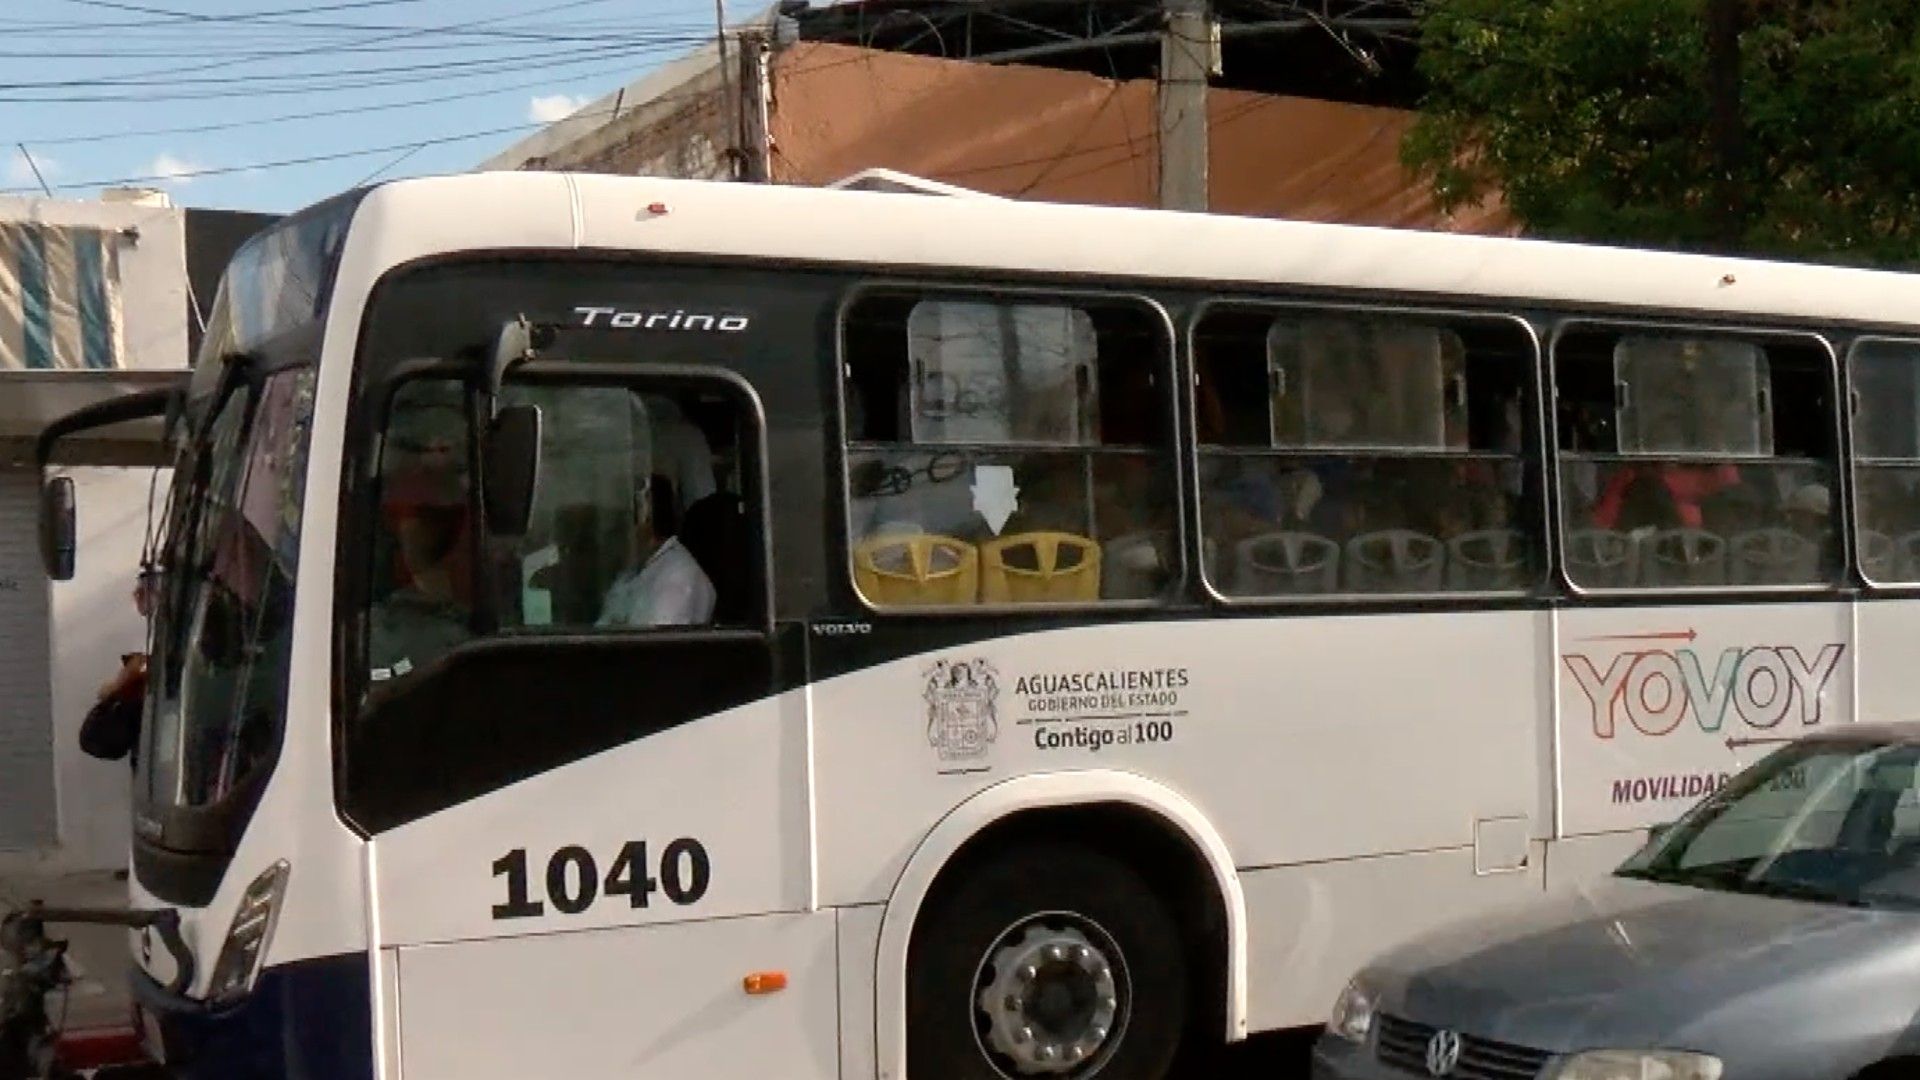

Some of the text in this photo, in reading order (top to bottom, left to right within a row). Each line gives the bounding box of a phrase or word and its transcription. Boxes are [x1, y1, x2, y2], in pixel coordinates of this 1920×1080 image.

[574, 306, 749, 331] Torino
[811, 623, 872, 635] VOLVO
[1015, 668, 1189, 695] AGUASCALIENTES
[1028, 691, 1178, 712] GOBIERNO DEL ESTADO
[1034, 721, 1173, 751] Contigo al 100
[492, 837, 711, 920] 1040
